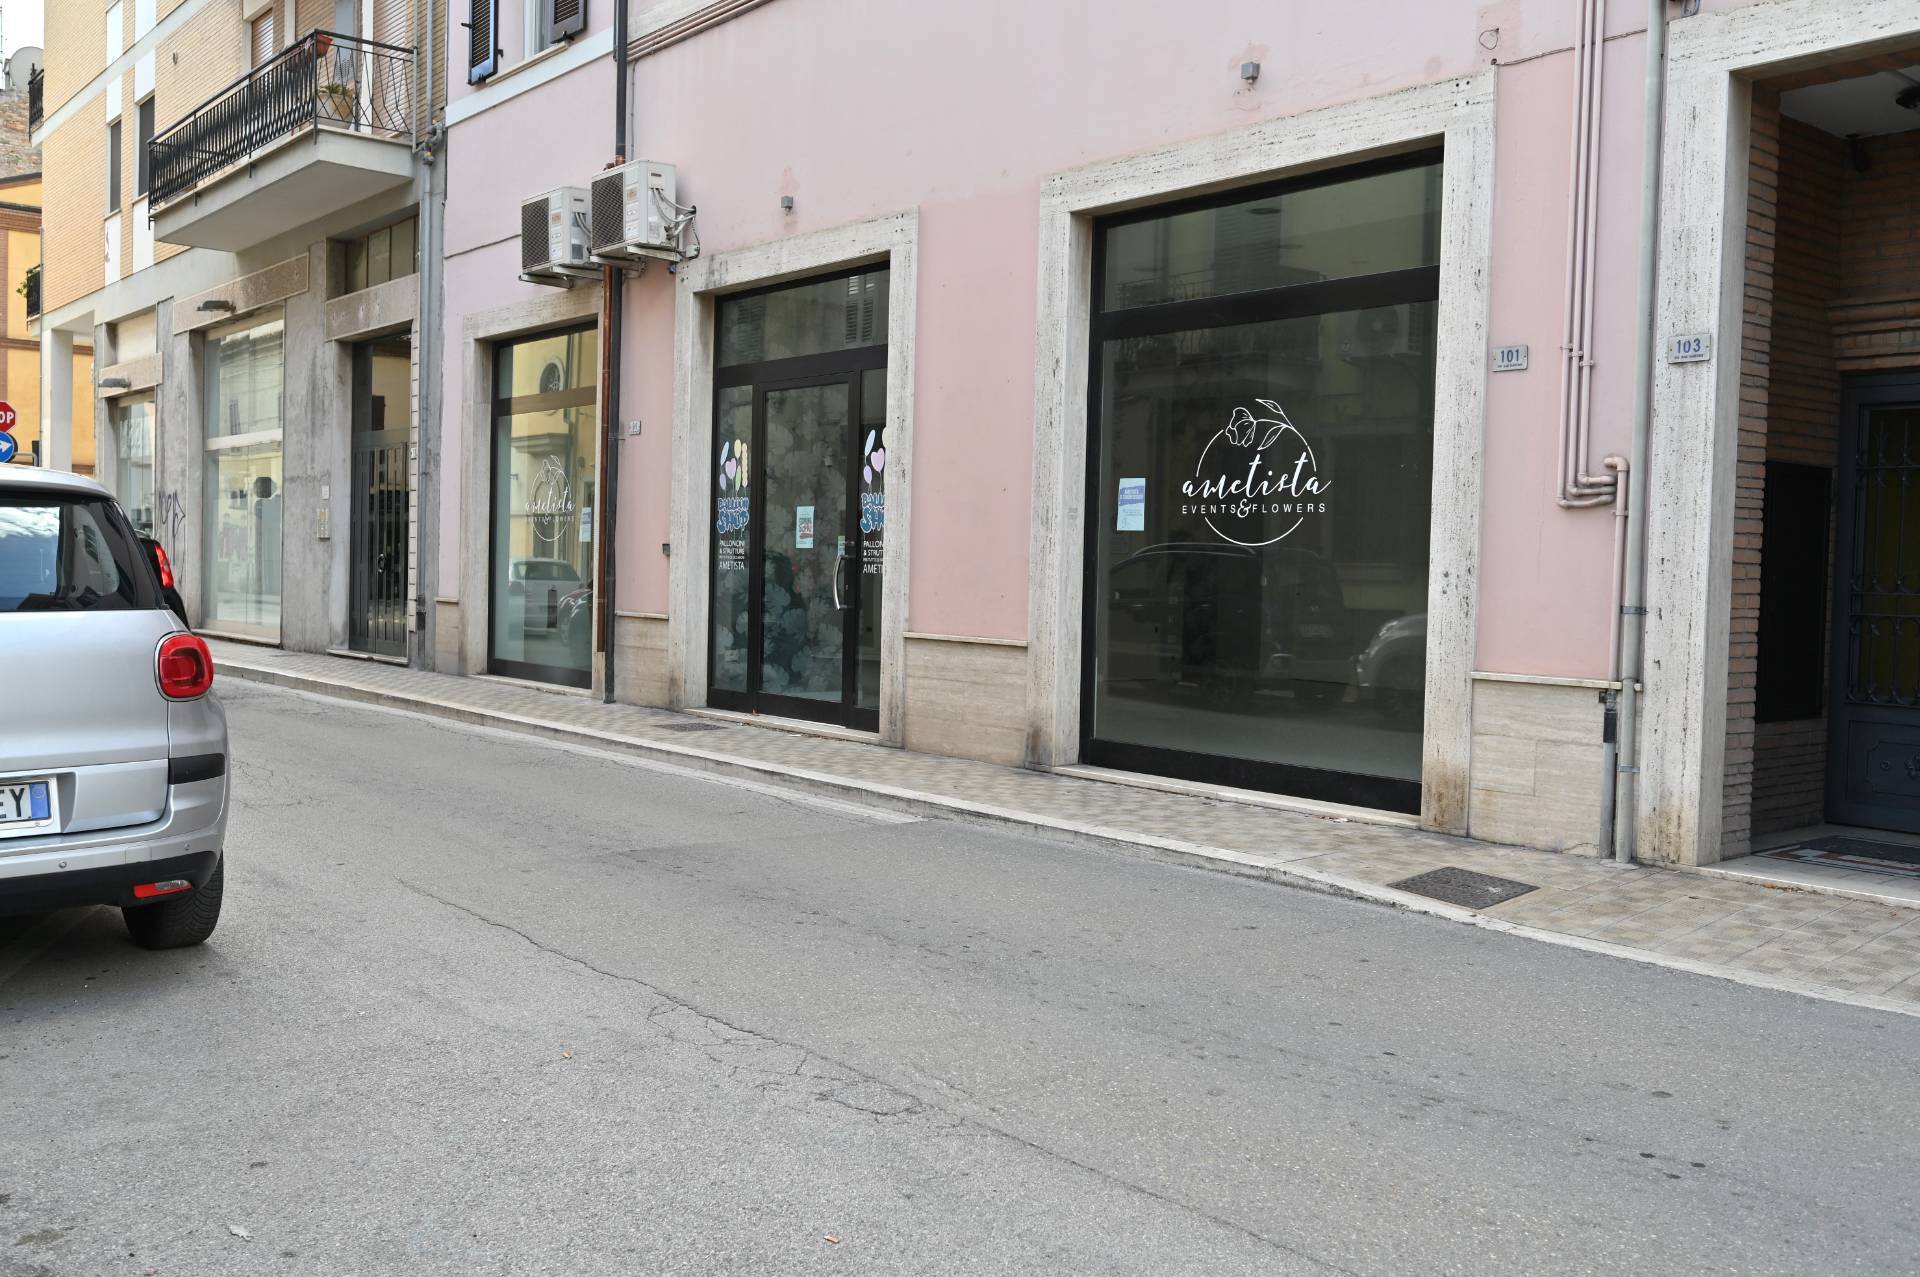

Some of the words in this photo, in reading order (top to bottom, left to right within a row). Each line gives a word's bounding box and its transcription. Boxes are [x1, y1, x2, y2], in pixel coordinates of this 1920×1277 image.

[1500, 348, 1520, 363] 101
[1676, 338, 1701, 354] 103
[1182, 452, 1332, 499] ametista
[525, 486, 576, 513] ametista
[717, 510, 750, 533] SHOP
[719, 561, 745, 570] AMETISTA
